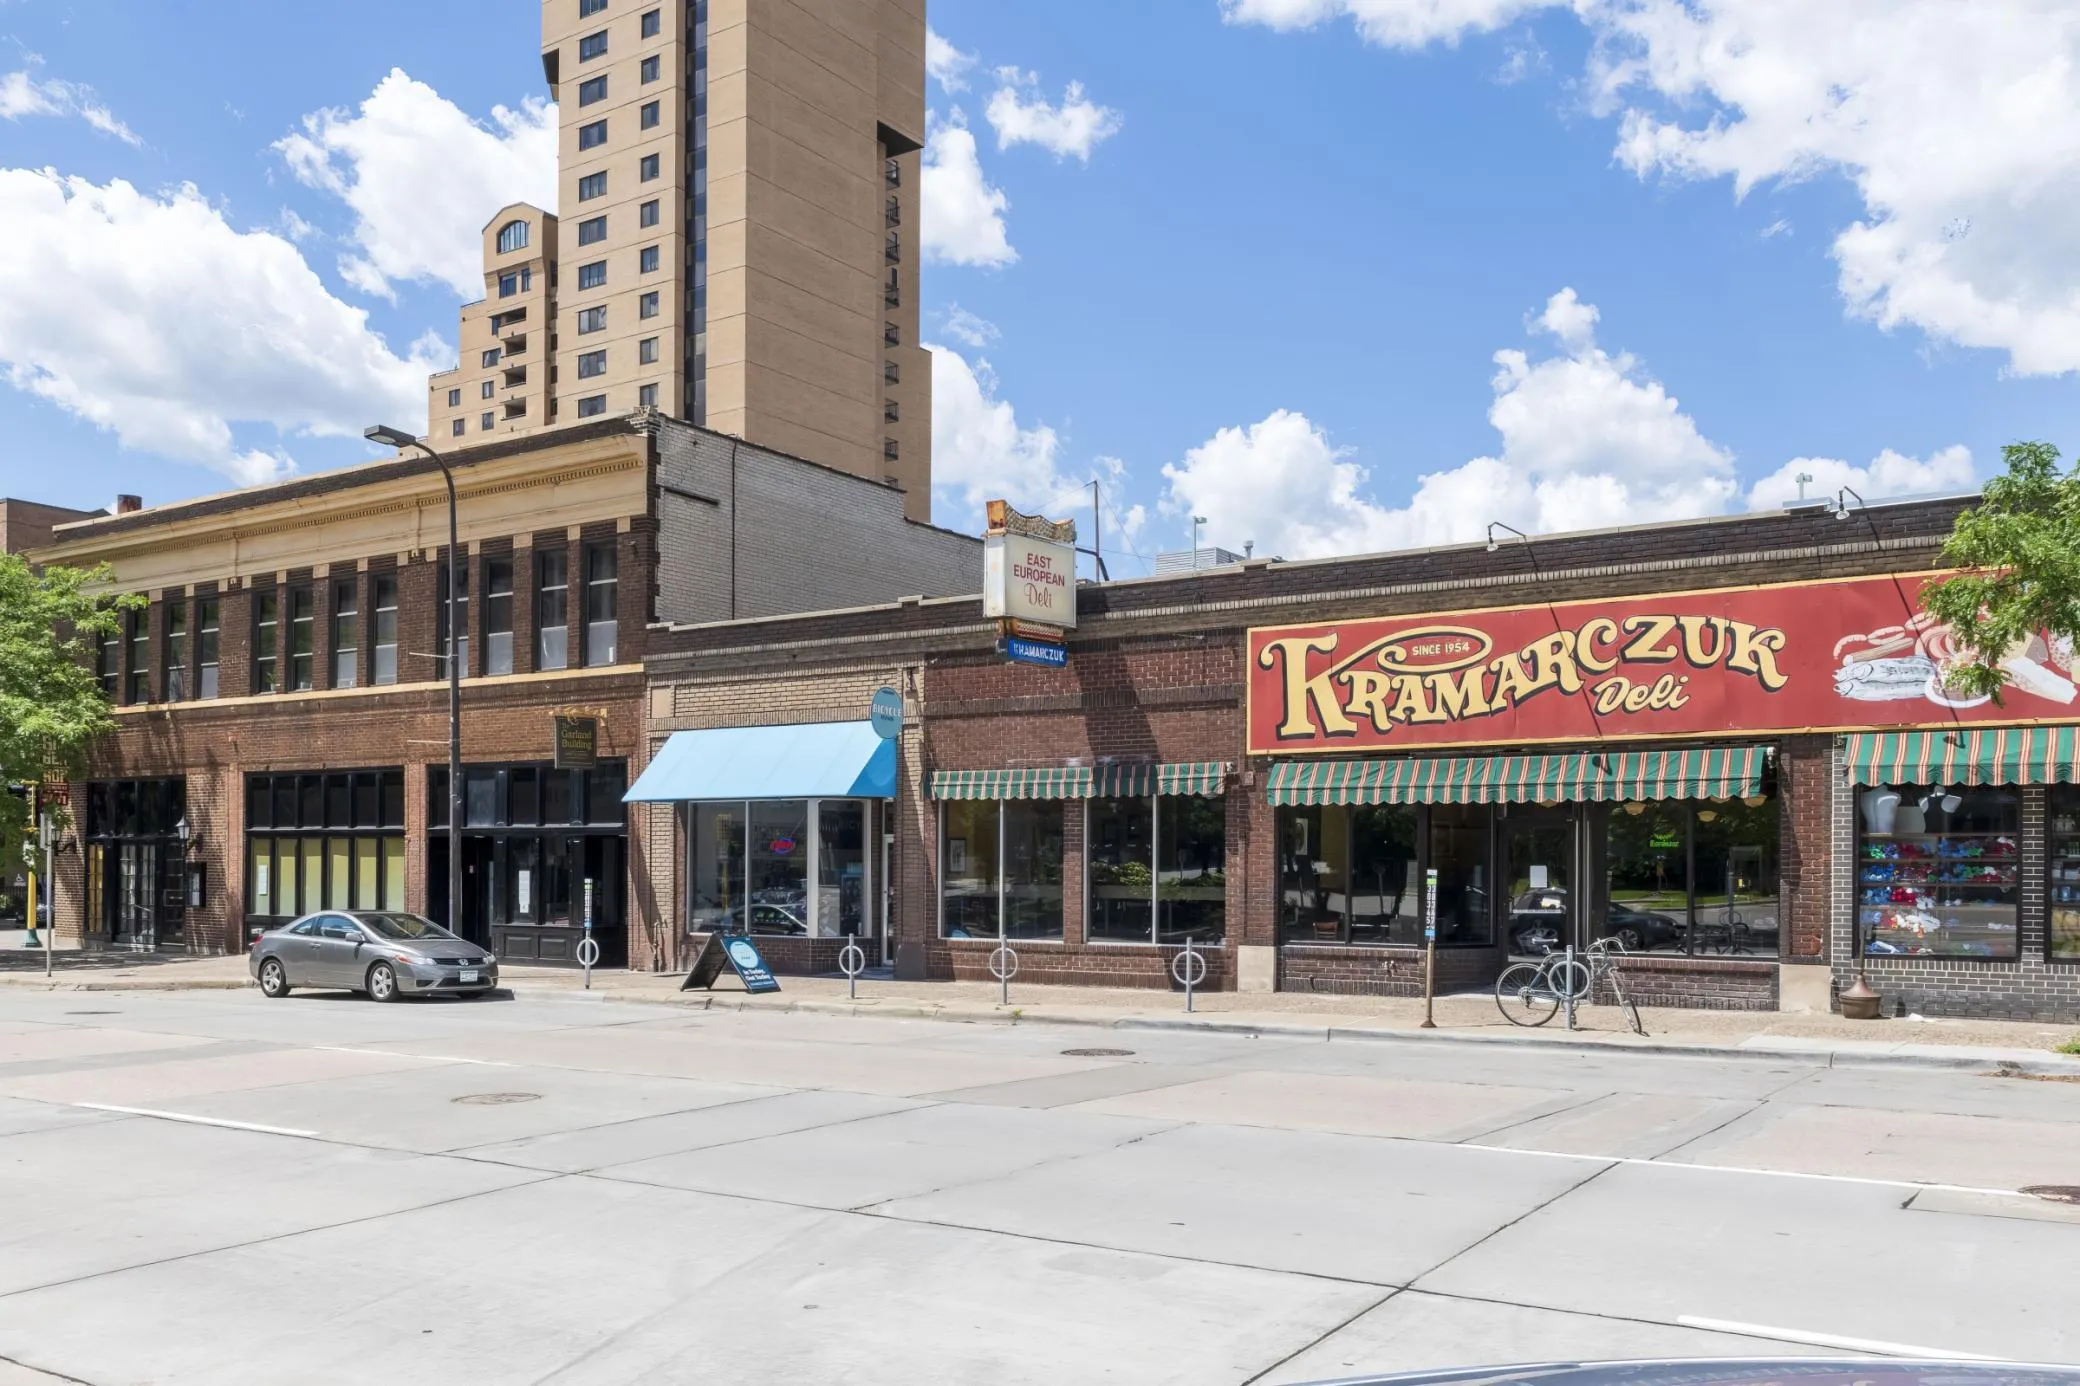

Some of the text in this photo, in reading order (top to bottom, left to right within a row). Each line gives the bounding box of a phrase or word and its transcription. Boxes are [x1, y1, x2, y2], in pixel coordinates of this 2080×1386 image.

[1027, 553, 1052, 569] EAST
[1014, 565, 1065, 587] EUROPEAN
[1023, 583, 1052, 609] Deli
[1412, 641, 1471, 656] SINCE 1954
[1258, 615, 1790, 742] KRAMARCZUK
[1590, 674, 1691, 716] Deli
[873, 704, 902, 717] BICYCLE
[561, 729, 592, 738] Garland
[561, 739, 592, 750] Building
